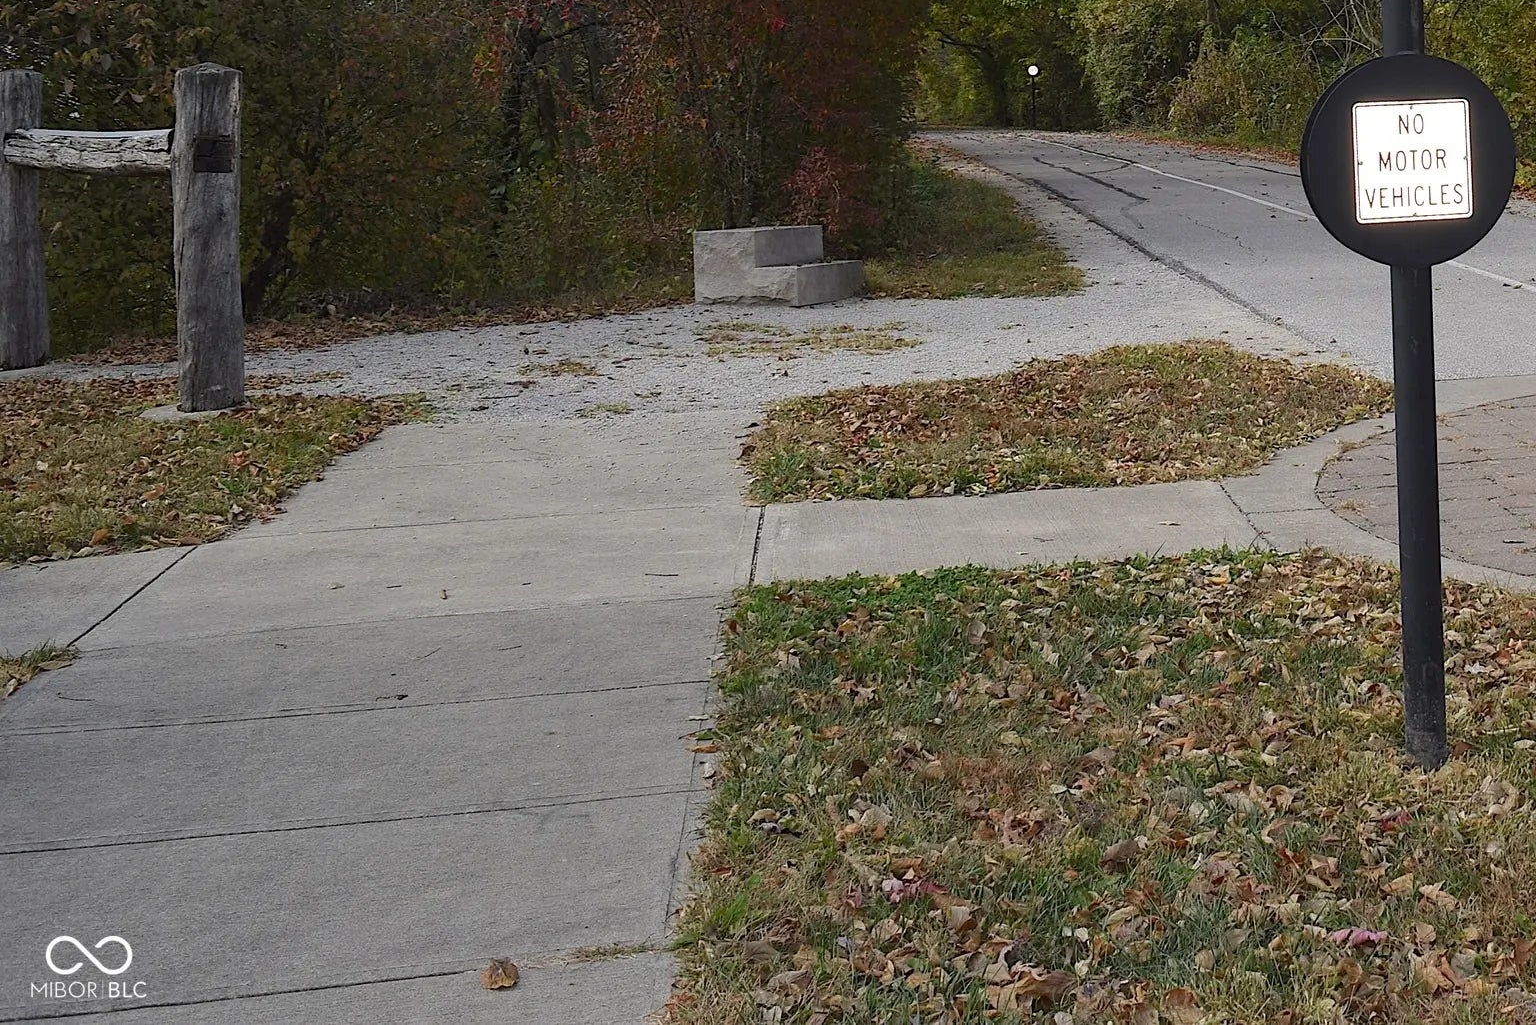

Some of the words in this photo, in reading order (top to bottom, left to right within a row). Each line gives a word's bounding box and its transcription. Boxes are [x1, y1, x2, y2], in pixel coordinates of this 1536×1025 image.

[1398, 113, 1425, 135] NO
[1378, 148, 1447, 172] MOTOR
[1364, 183, 1464, 209] VEHICLES
